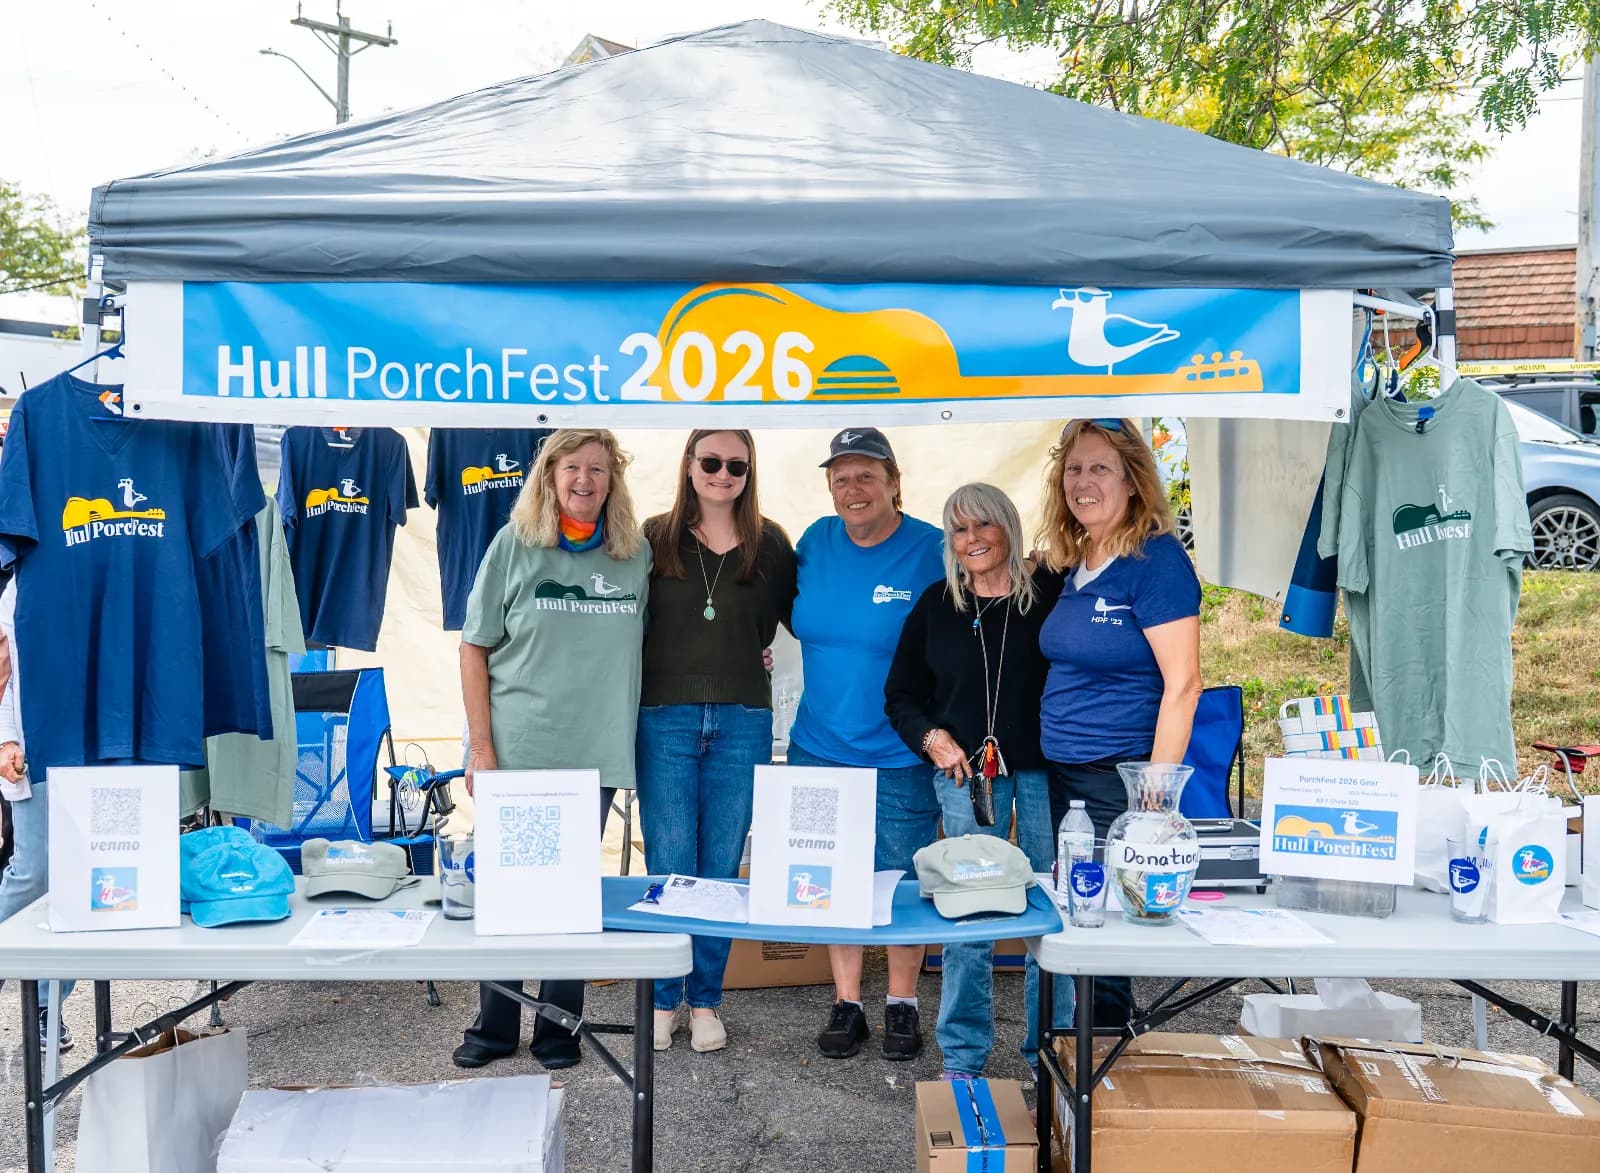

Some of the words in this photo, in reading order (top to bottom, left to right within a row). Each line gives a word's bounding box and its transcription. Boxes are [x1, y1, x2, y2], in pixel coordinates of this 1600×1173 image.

[217, 345, 328, 398] Hull
[347, 346, 610, 402] PorchFest
[618, 331, 815, 402] 2026
[483, 476, 524, 491] PorchFe
[306, 502, 327, 518] Hull
[1396, 526, 1435, 550] Hull
[535, 598, 567, 612] Hull
[569, 600, 637, 615] PorchFest
[89, 840, 141, 852] venmo
[788, 837, 837, 851] venmo
[1274, 837, 1309, 852] Hull
[1313, 839, 1395, 859] PorchFest
